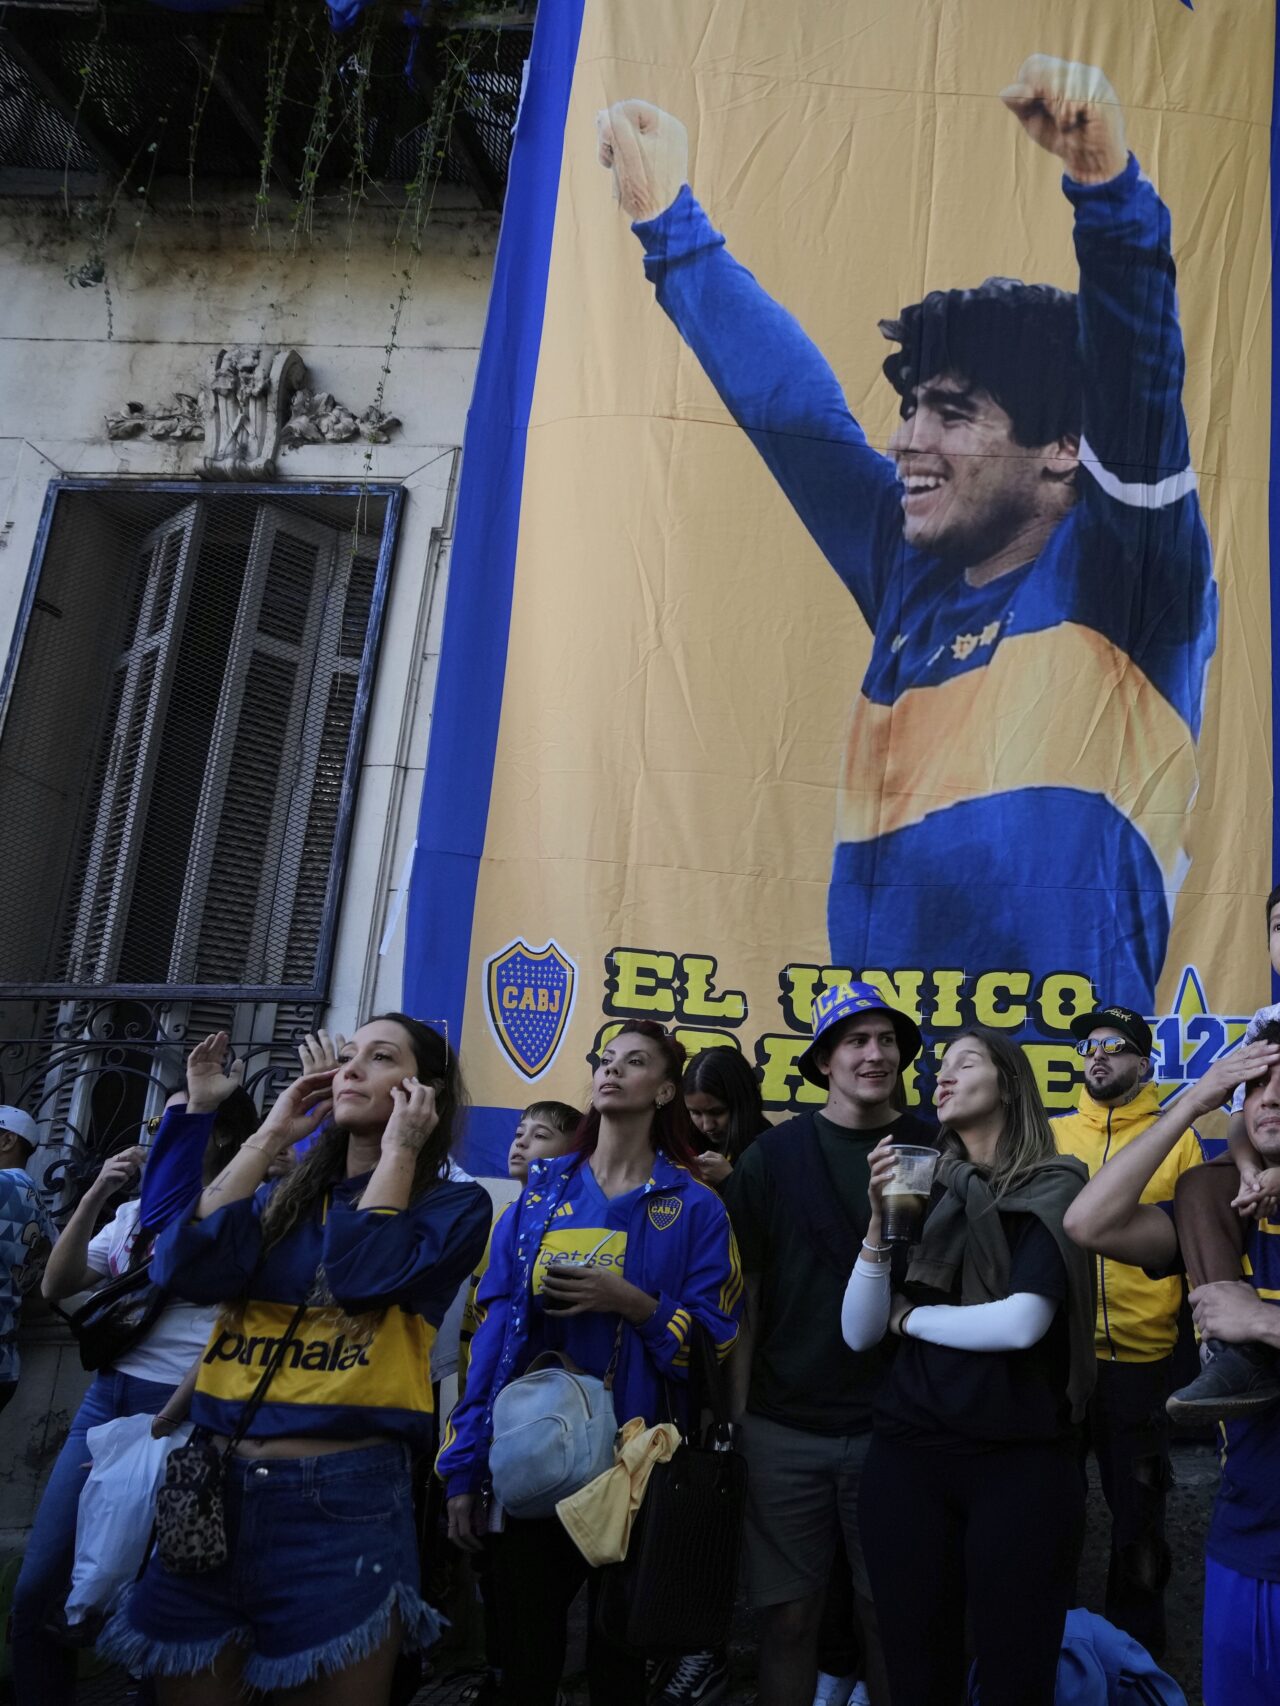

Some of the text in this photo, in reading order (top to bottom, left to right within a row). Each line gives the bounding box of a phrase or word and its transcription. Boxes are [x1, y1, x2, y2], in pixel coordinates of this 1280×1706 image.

[503, 986, 560, 1013] CABJ
[603, 948, 747, 1026] EL
[779, 964, 1103, 1038] UNICO
[1157, 1017, 1226, 1079] 12
[651, 1206, 677, 1216] CABJ
